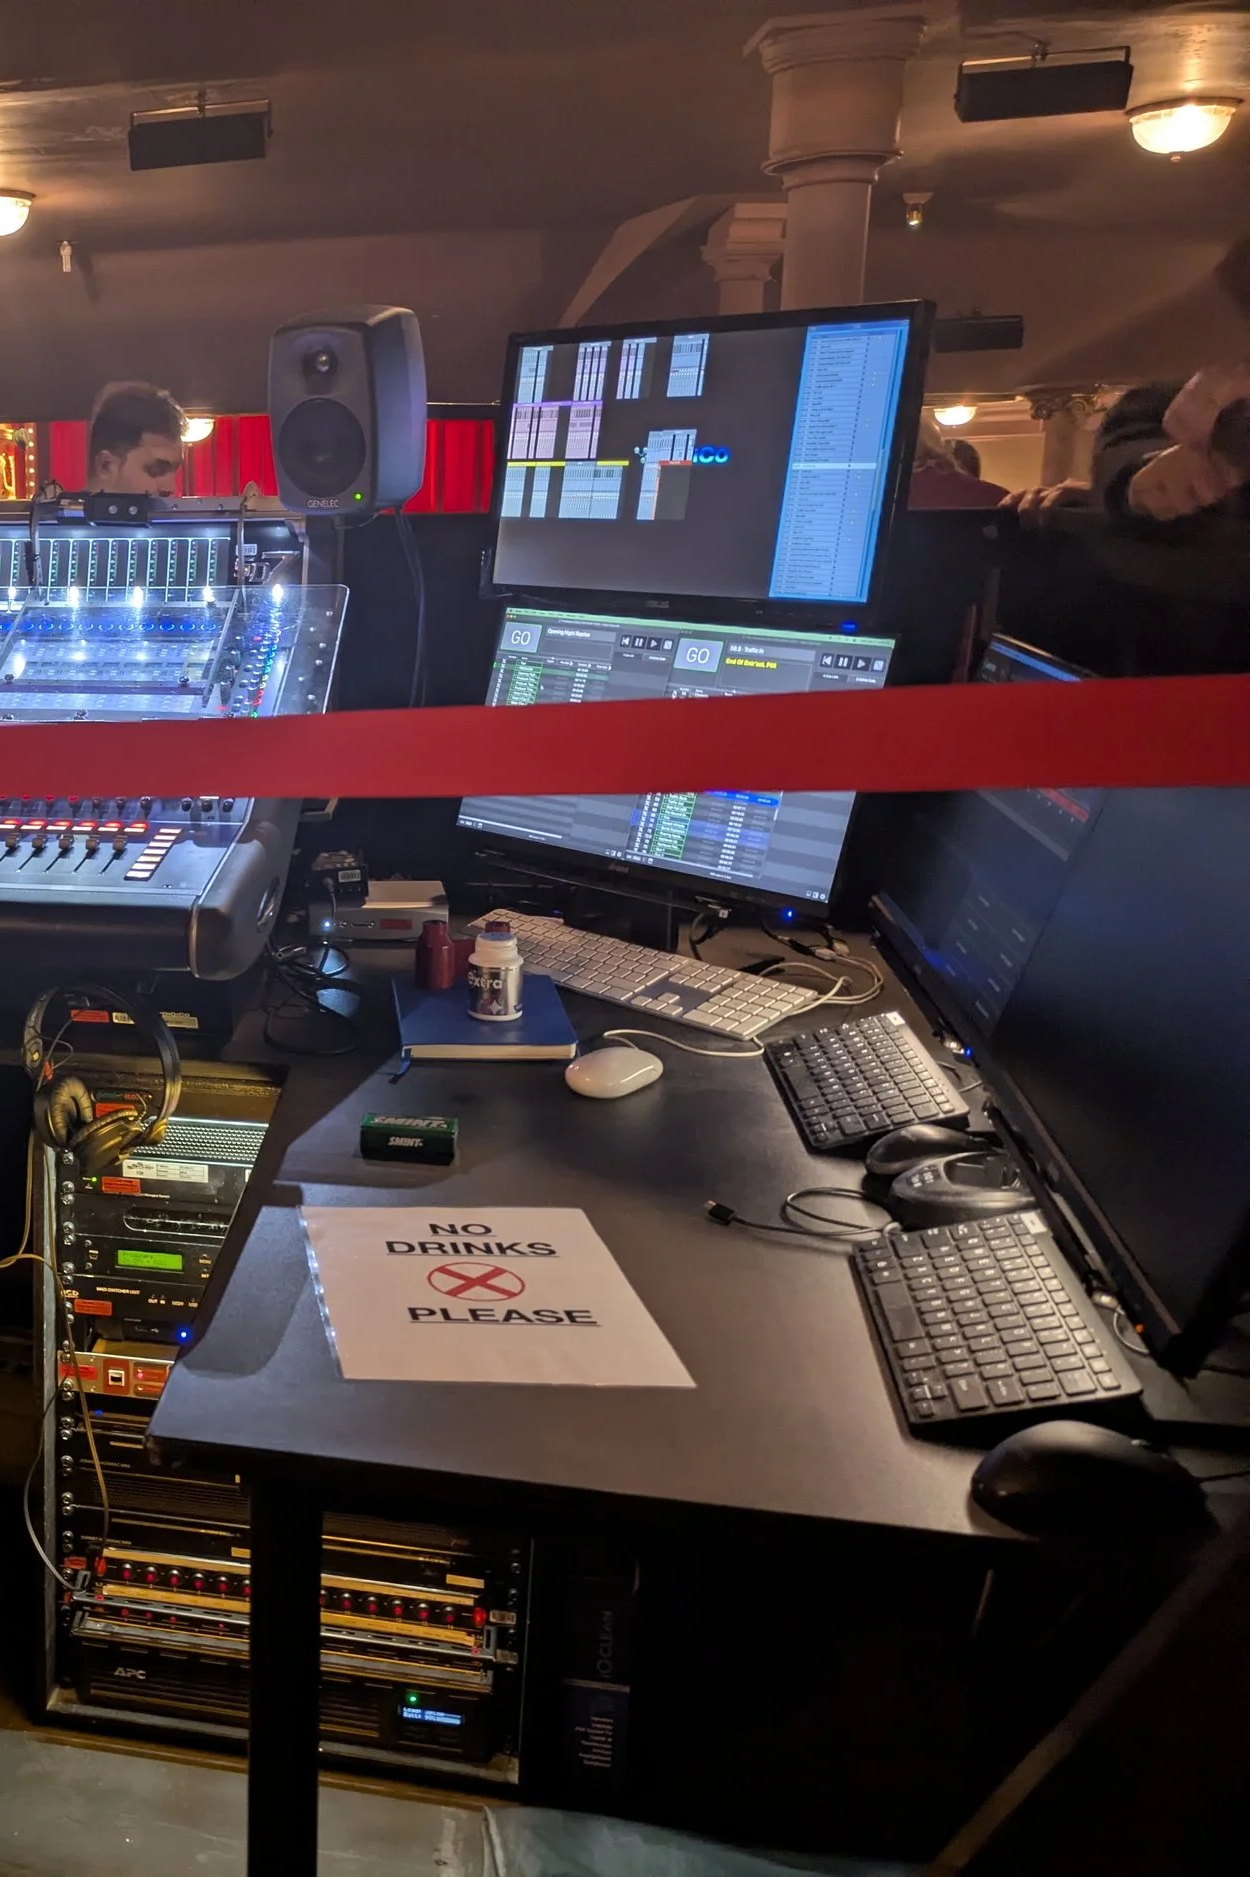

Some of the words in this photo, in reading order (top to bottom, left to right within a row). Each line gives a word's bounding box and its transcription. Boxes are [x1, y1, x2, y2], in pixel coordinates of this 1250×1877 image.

[692, 447, 729, 463] iCo
[307, 499, 340, 509] GENELEC
[510, 630, 532, 645] GO
[686, 647, 710, 664] GO
[467, 970, 503, 989] extra
[388, 1136, 423, 1148] SMINT
[429, 1223, 492, 1235] NO
[385, 1241, 557, 1256] DRINKS
[407, 1307, 598, 1325] PLEASE
[113, 1667, 146, 1680] APC
